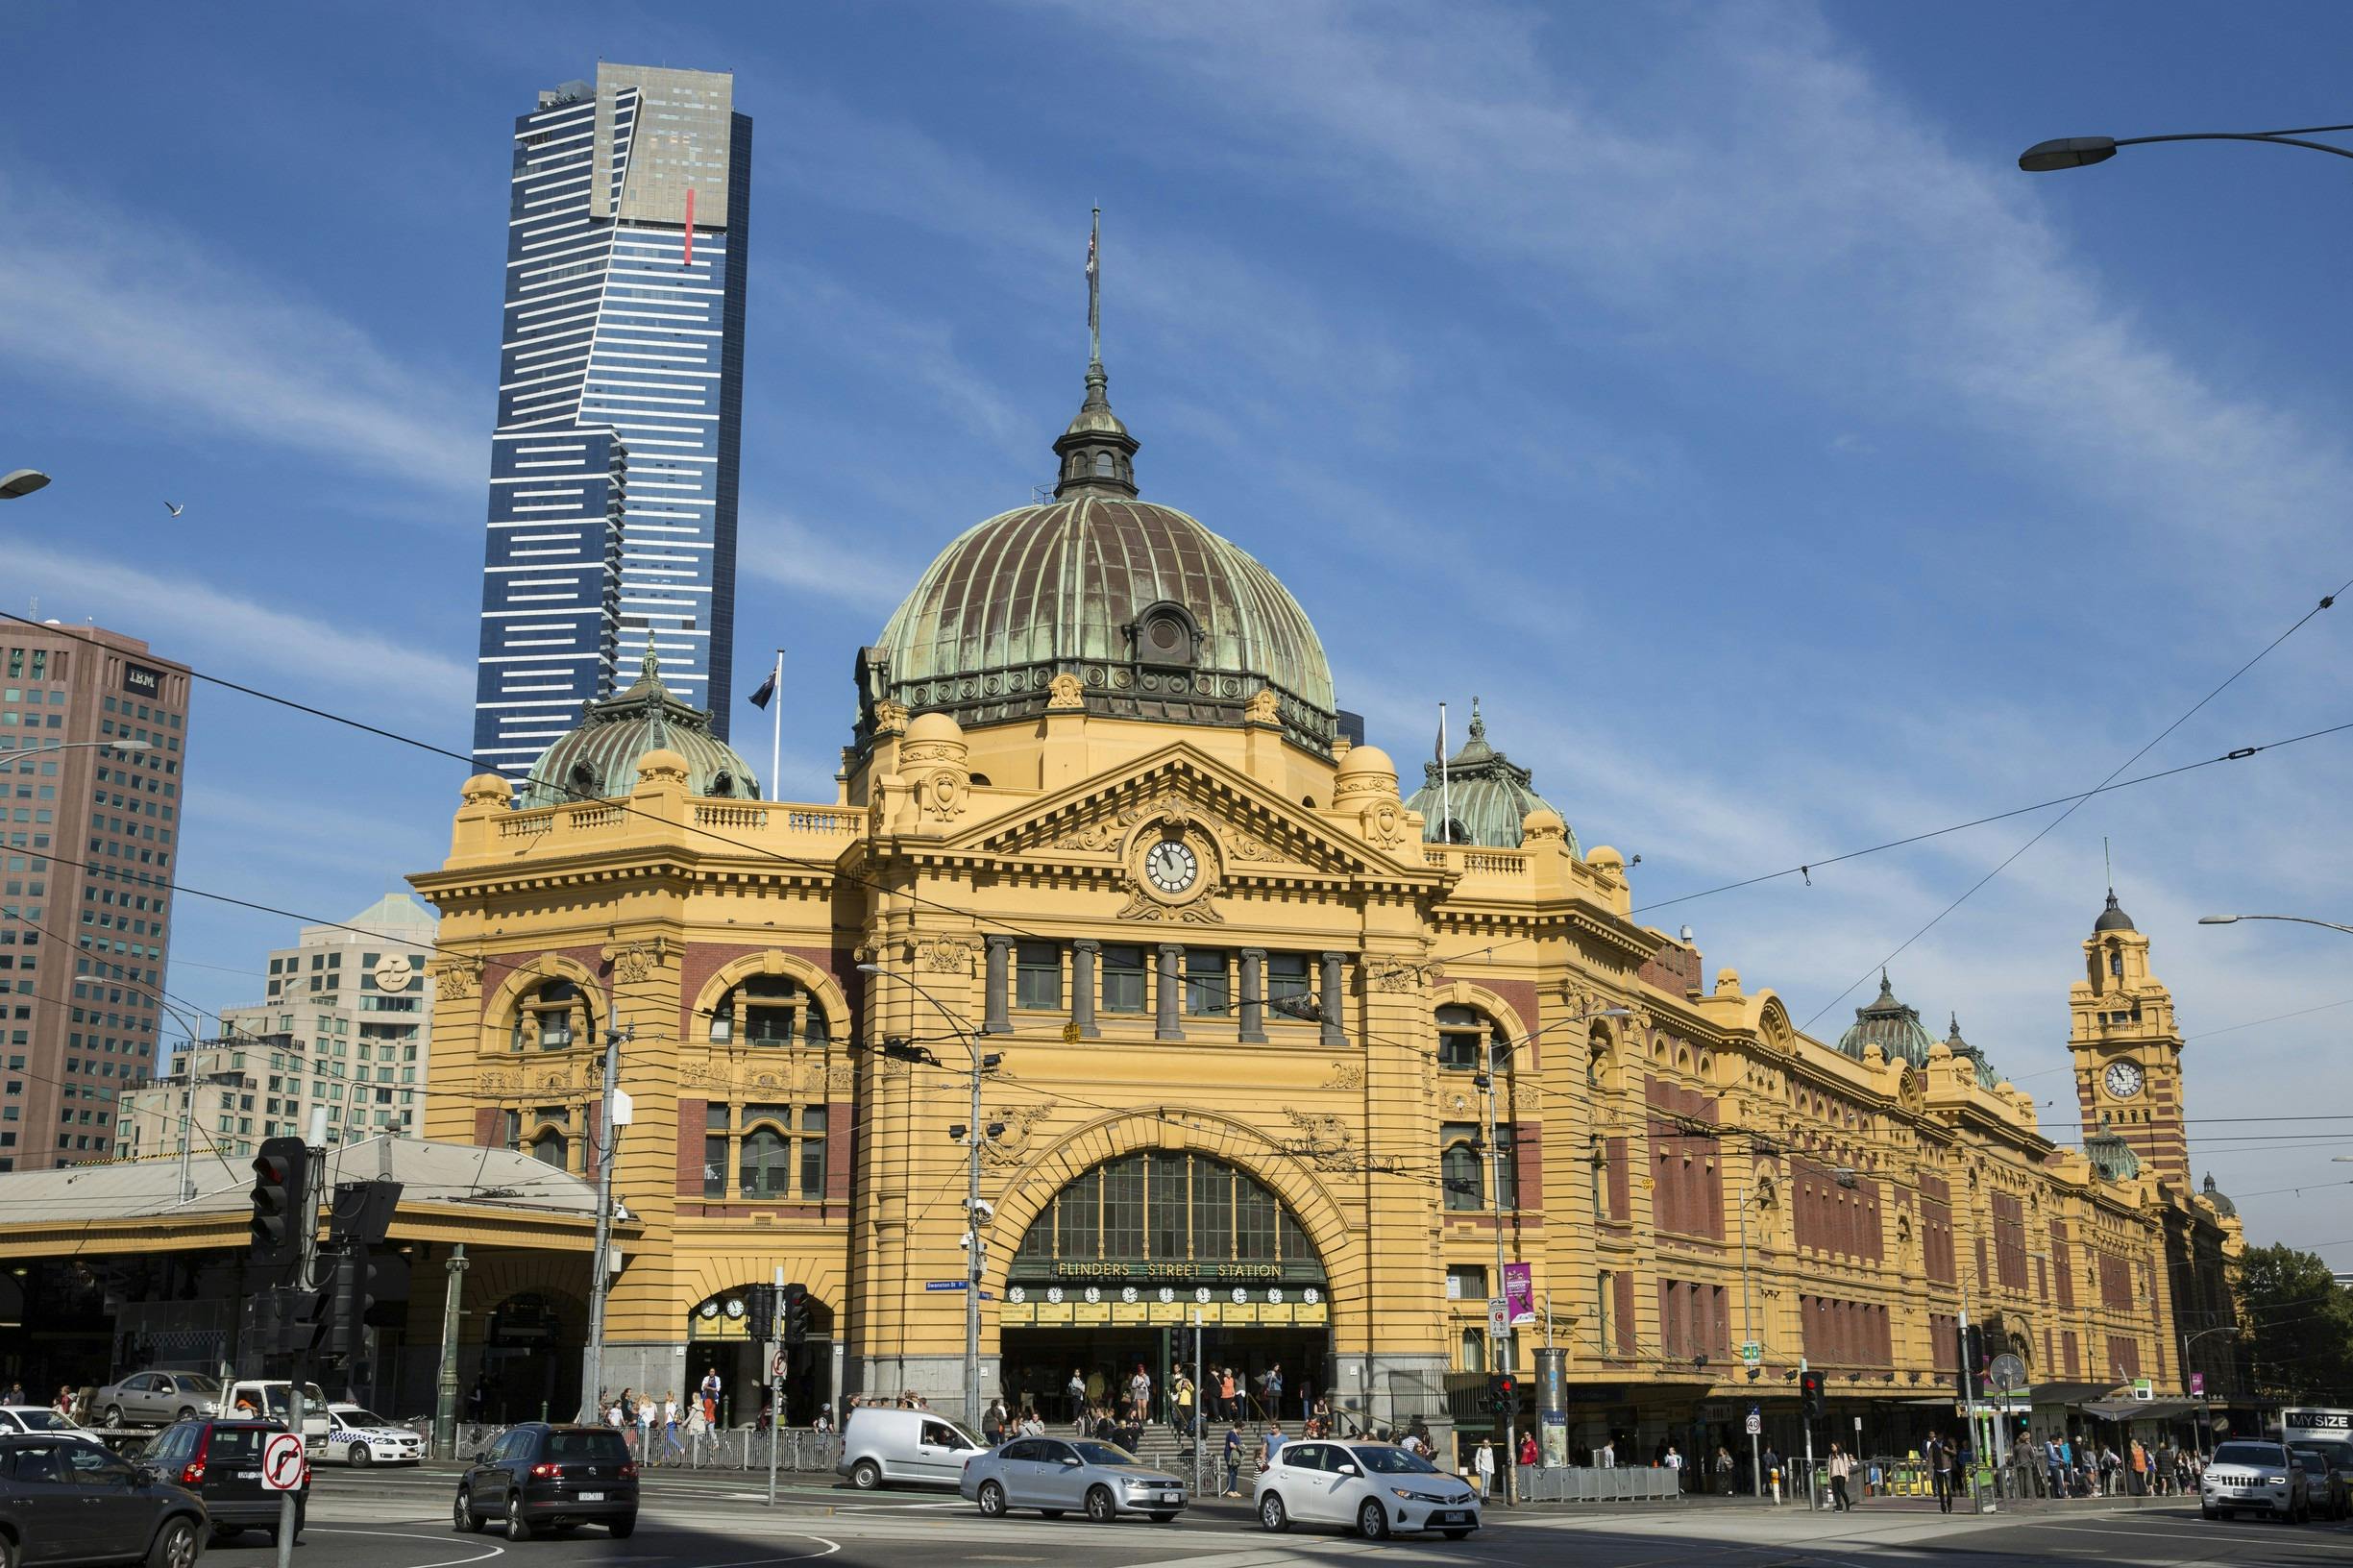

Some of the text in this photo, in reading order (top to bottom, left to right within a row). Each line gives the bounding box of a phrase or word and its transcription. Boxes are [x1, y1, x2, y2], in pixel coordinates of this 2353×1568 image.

[129, 672, 155, 688] IBM
[1059, 1262, 1282, 1277] FLINDERS STREET STATION
[2292, 1414, 2348, 1428] MY SIZE
